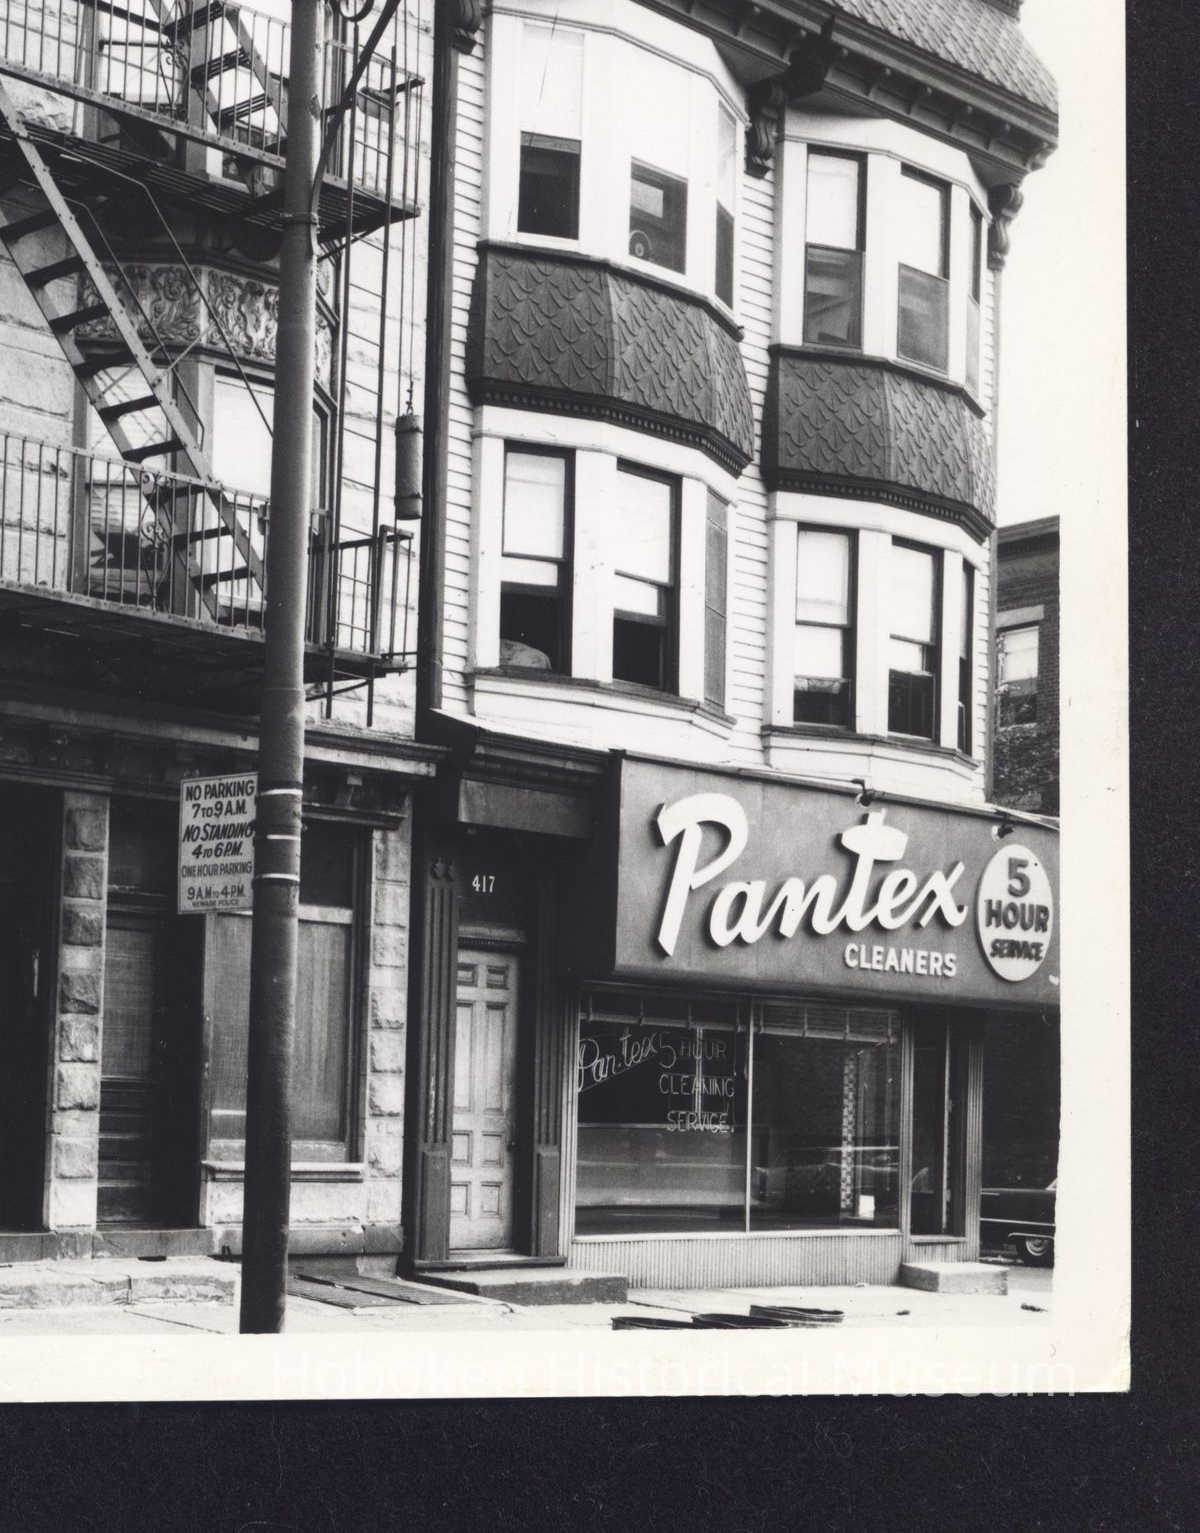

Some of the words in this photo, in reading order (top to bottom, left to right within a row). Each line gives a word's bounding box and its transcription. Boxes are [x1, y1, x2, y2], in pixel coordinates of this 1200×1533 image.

[185, 784, 202, 802] NO
[204, 779, 255, 800] PARKING
[192, 803, 201, 819] 7
[214, 800, 223, 818] 9
[182, 824, 200, 843] NO
[200, 822, 253, 842] STANDING
[192, 844, 203, 859] 4
[214, 842, 224, 858] 6
[181, 865, 196, 878] ONE
[198, 863, 218, 877] HOUR
[220, 861, 252, 876] PARKING
[657, 793, 968, 957] Pantex
[1008, 857, 1031, 898] 5
[187, 886, 196, 900] 9
[220, 884, 230, 898] 4
[472, 874, 496, 893] 417
[985, 898, 1050, 934] HOUR
[845, 943, 957, 978] CLEANERS
[991, 938, 1044, 962] SERVICE
[659, 1031, 677, 1068] 5
[681, 1040, 727, 1060] HOUR
[659, 1073, 735, 1098] CLEANING
[667, 1110, 729, 1133] SERVICE
